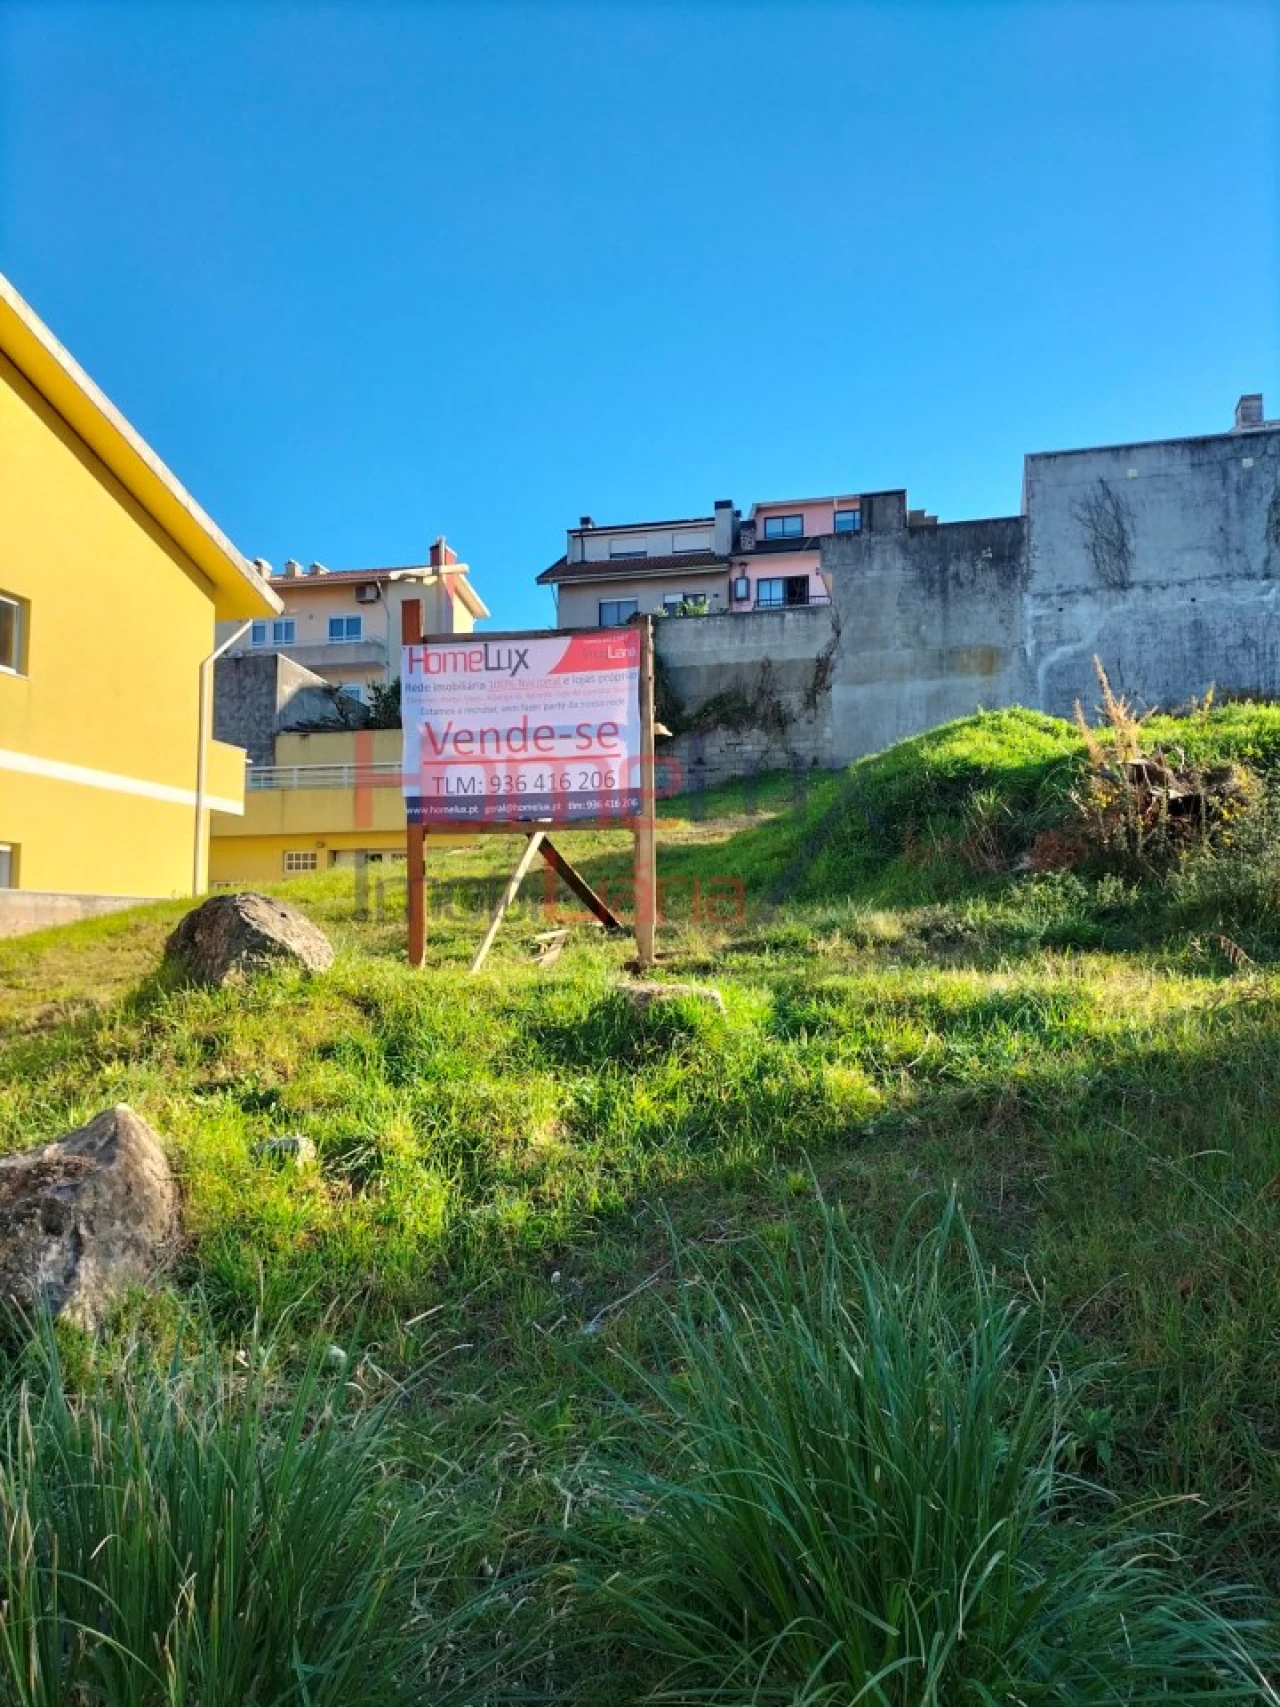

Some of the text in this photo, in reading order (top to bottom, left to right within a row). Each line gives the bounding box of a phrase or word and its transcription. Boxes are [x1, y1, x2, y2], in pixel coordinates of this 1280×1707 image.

[408, 643, 529, 677] HomeLux
[405, 683, 430, 693] Rede
[425, 714, 620, 756] Vende-se
[431, 769, 616, 794] TLM: 936 416 206
